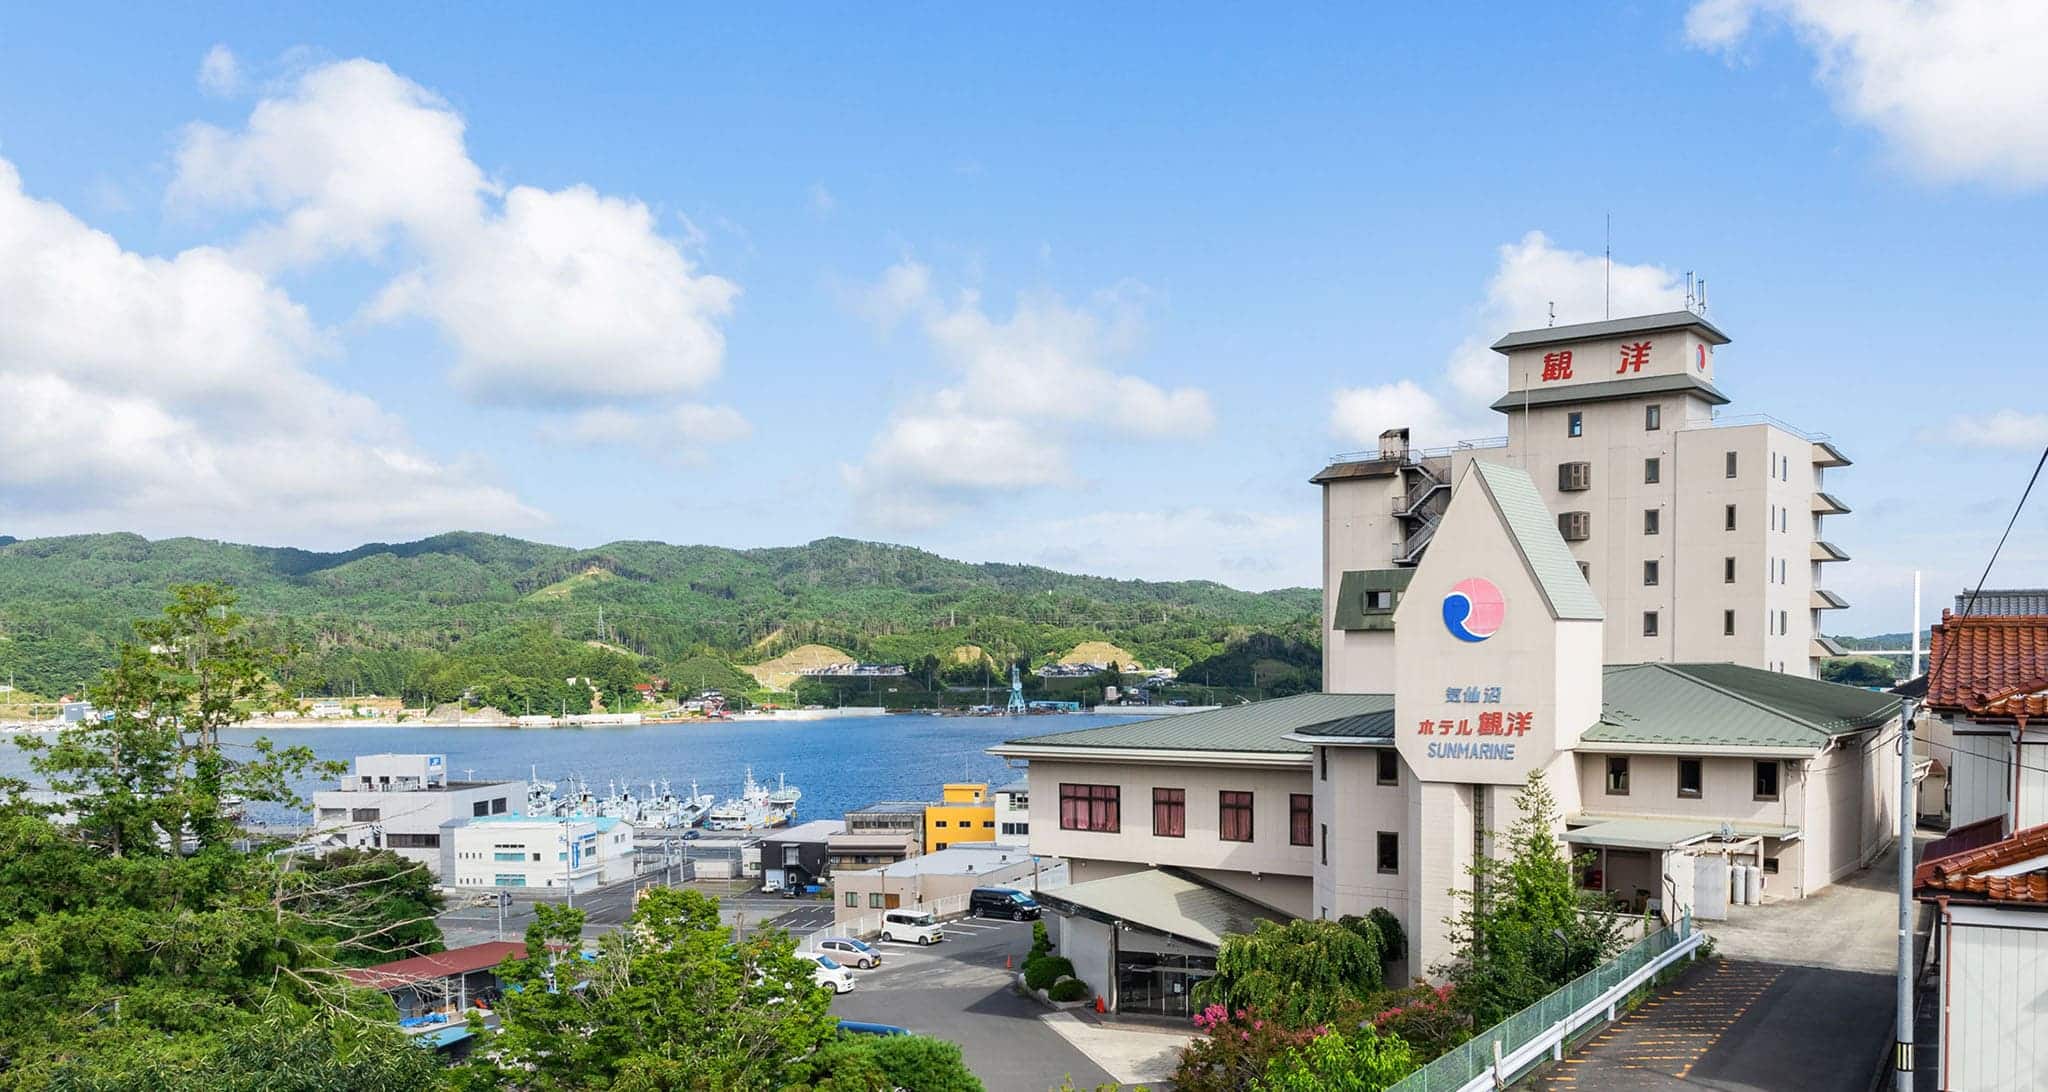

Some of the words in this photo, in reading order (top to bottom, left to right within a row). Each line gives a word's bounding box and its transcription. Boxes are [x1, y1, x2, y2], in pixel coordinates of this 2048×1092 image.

[1445, 686, 1502, 703] 気仙沼
[1427, 741, 1515, 760] SUNMARINE
